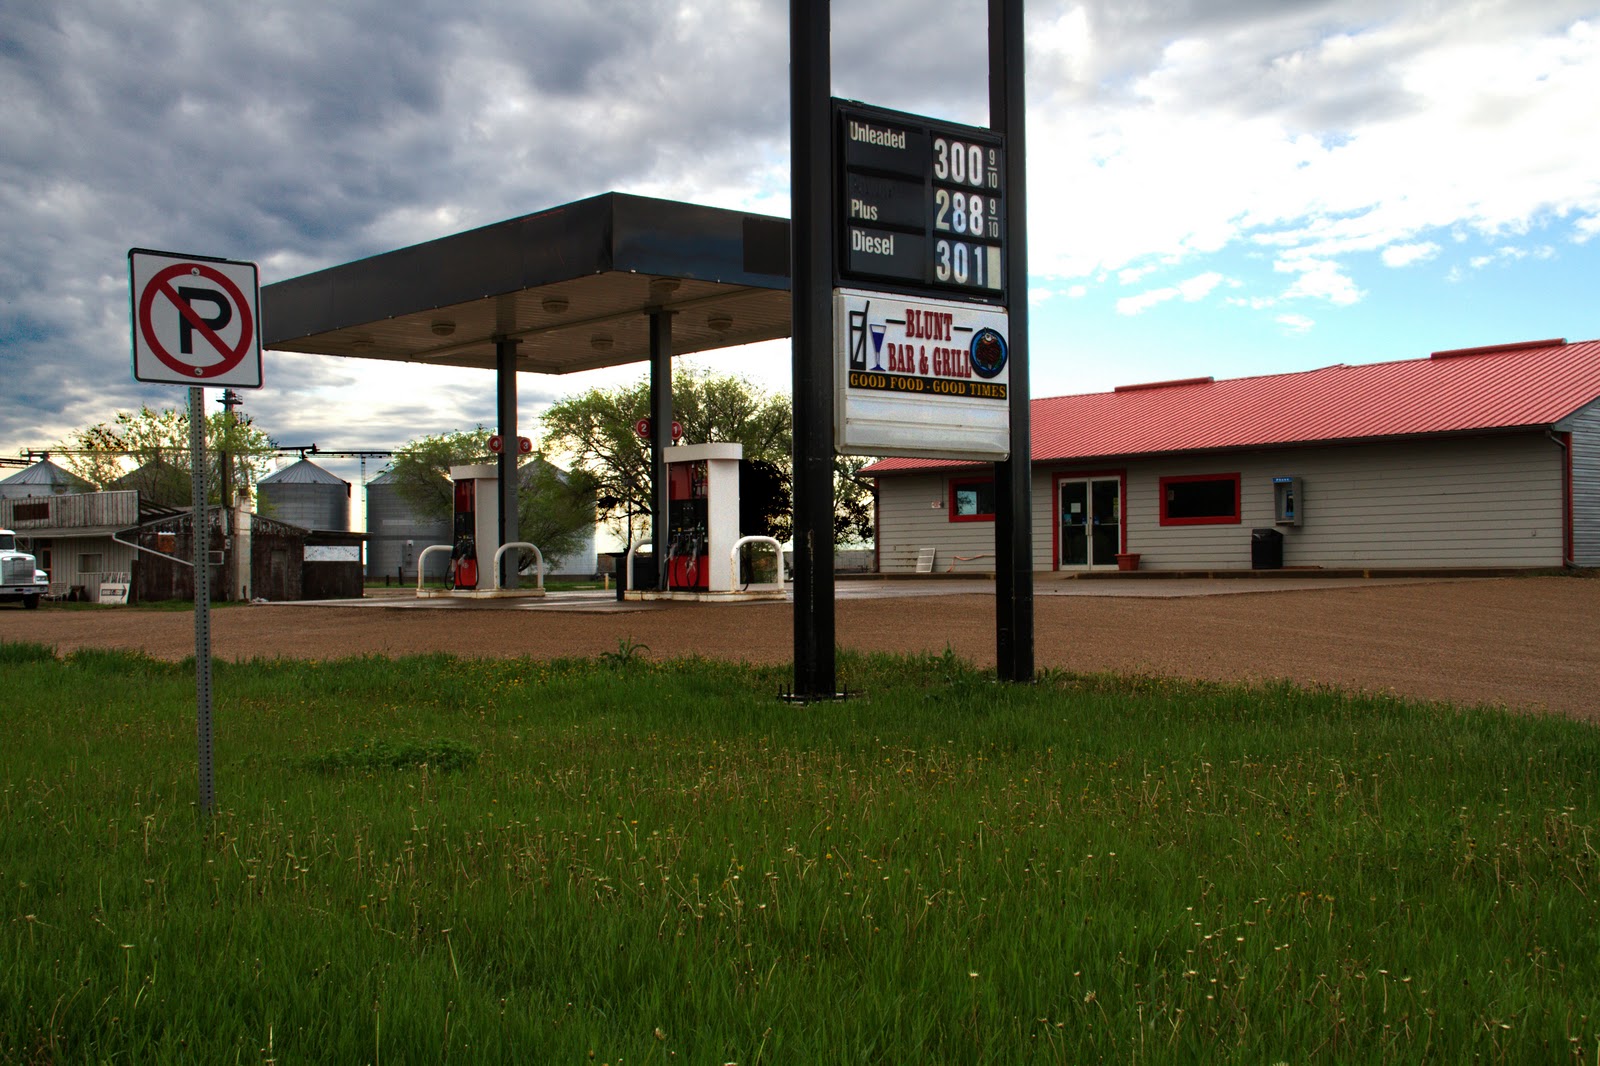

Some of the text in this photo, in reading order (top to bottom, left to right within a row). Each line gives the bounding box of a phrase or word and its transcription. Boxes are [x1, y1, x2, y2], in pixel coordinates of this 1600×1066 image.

[850, 122, 906, 149] Unleaded
[934, 138, 983, 186] 300
[851, 199, 878, 221] Plus
[935, 189, 983, 236] 288
[852, 229, 894, 255] Diesel
[936, 239, 983, 286] 301
[178, 286, 232, 354] P
[905, 308, 953, 341] BLUNT
[887, 343, 972, 378] BAR & GRILL
[850, 373, 886, 388] GOOD
[890, 376, 924, 391] FOOD
[933, 379, 966, 394] GOOD
[970, 383, 1006, 398] TIMES
[641, 423, 647, 433] 2
[673, 425, 678, 434] 1
